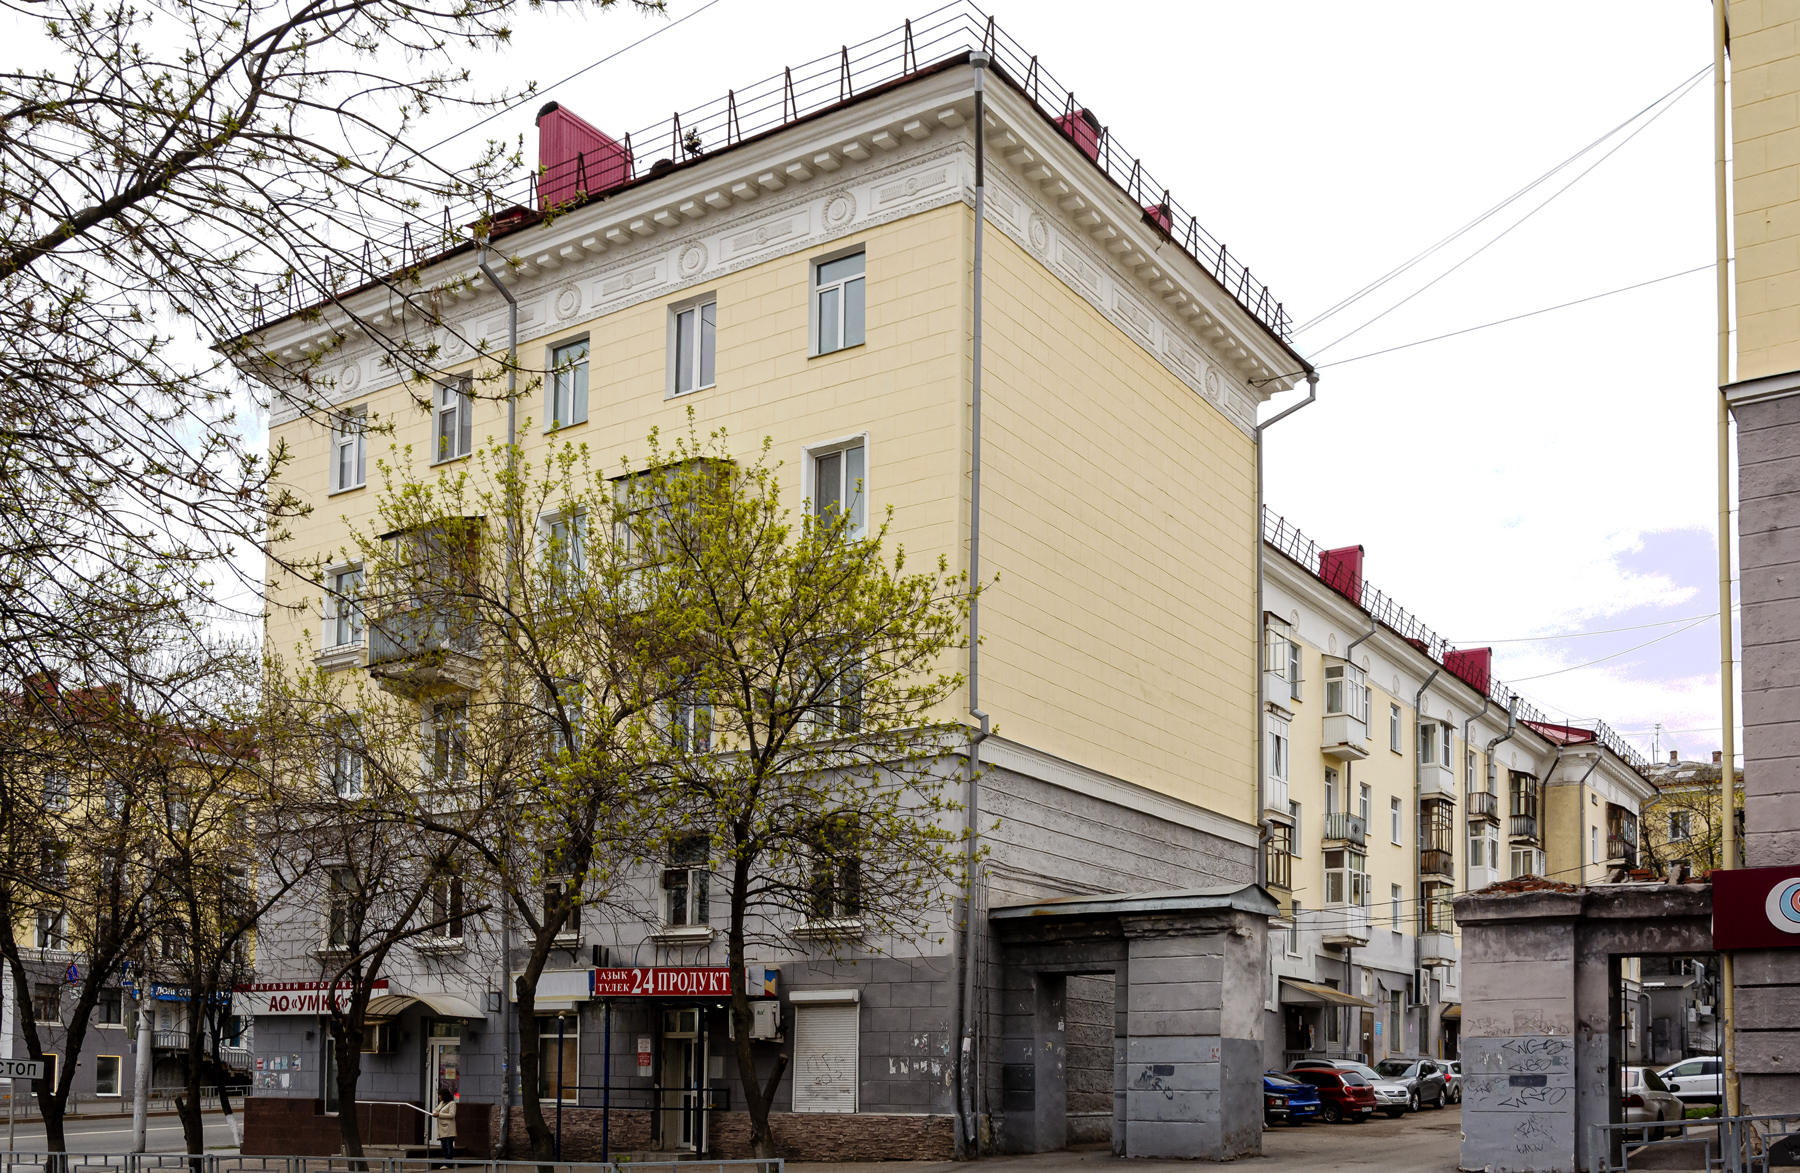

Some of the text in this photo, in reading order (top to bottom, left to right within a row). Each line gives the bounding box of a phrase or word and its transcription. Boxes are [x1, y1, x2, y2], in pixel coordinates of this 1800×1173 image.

[631, 968, 732, 994] 24 ПРОДУКТ
[250, 982, 299, 991] МАГАЗИН
[597, 983, 630, 992] ТҮЛЕК
